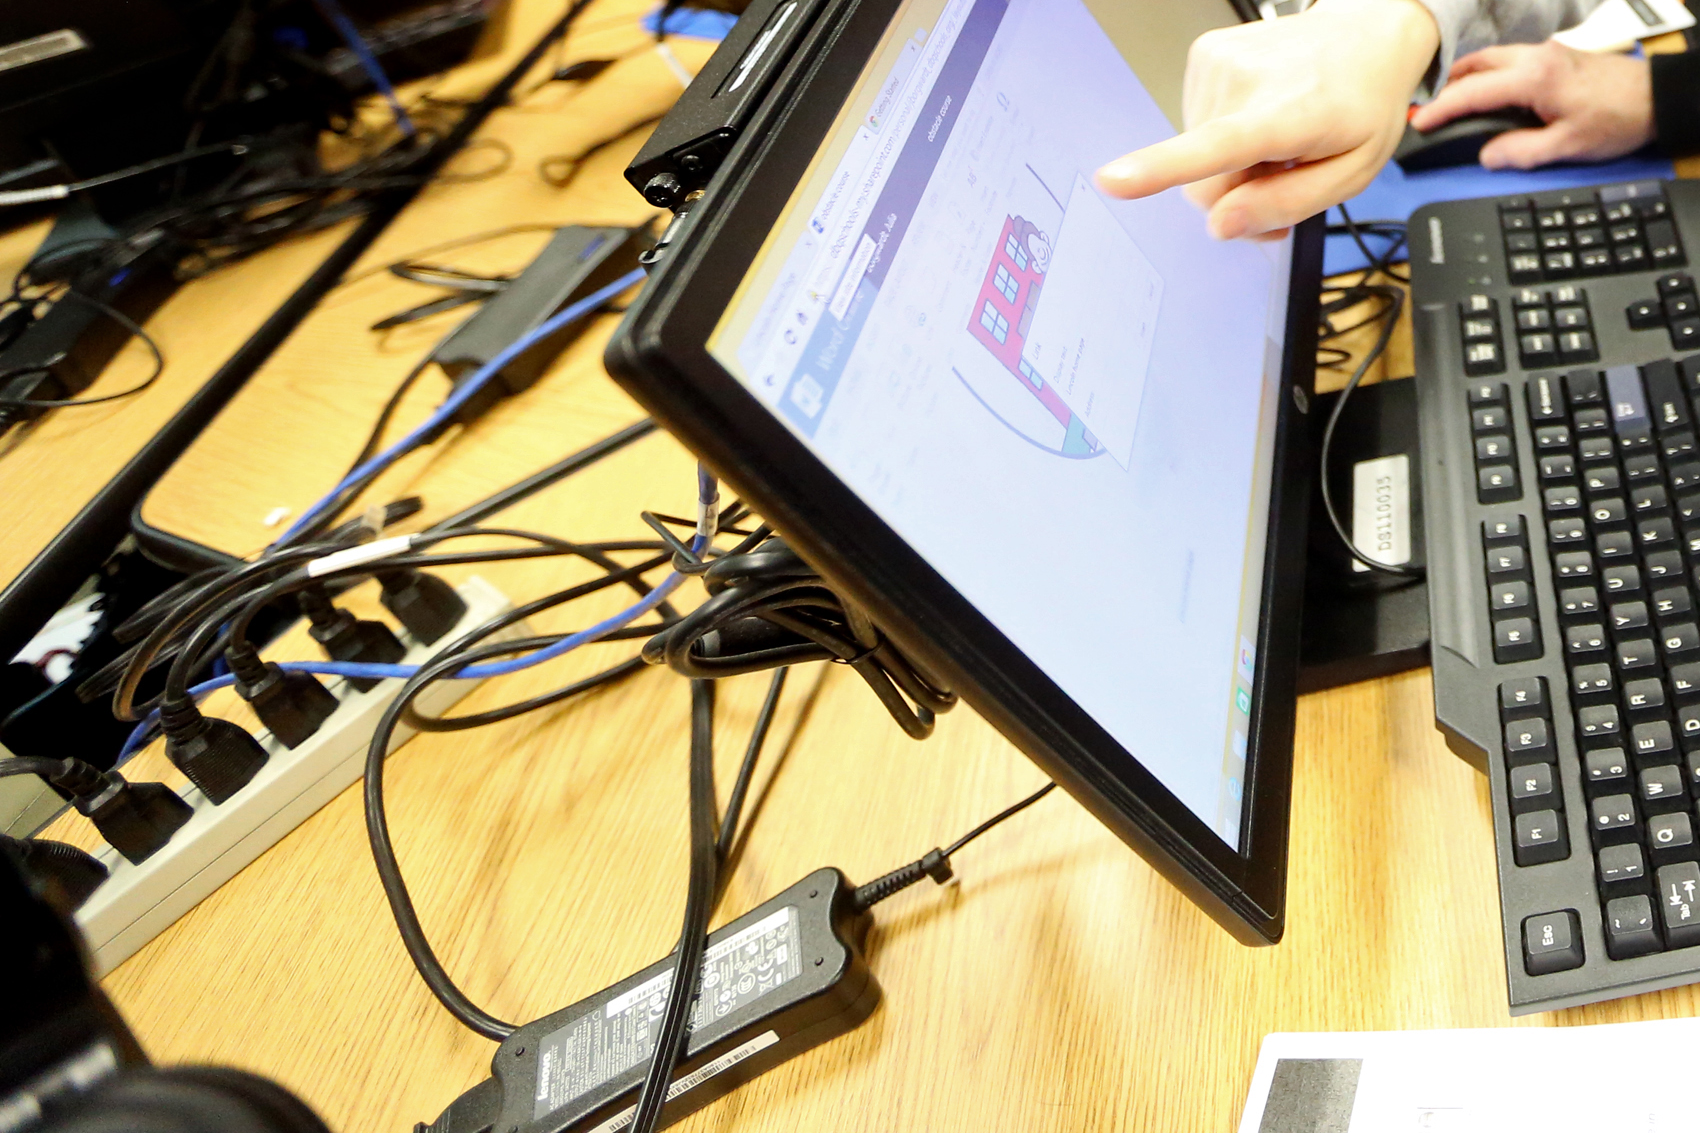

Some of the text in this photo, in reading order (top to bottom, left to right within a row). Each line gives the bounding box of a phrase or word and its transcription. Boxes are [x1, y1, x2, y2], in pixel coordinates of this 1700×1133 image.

[873, 75, 900, 121] Getting Started
[924, 92, 953, 144] obstacle course
[819, 168, 850, 222] obstacle course
[1030, 338, 1042, 361] Link
[1065, 369, 1077, 397] Lincoln
[1643, 531, 1657, 540] K
[1608, 578, 1623, 588] U
[1658, 600, 1673, 611] H
[1615, 615, 1631, 626] Y
[1666, 637, 1681, 648] G
[1676, 681, 1692, 689] F
[1631, 695, 1646, 705] R
[1685, 719, 1700, 731] D
[1520, 733, 1531, 744] F3
[1638, 739, 1654, 749] E
[1609, 765, 1624, 774] 3
[1526, 780, 1536, 791] F2
[1647, 783, 1663, 794] W
[1532, 829, 1542, 839] F1
[1657, 828, 1673, 842] Q
[1680, 902, 1692, 920] Tab
[1542, 925, 1553, 945] Esc
[536, 1049, 552, 1103] lenovo
